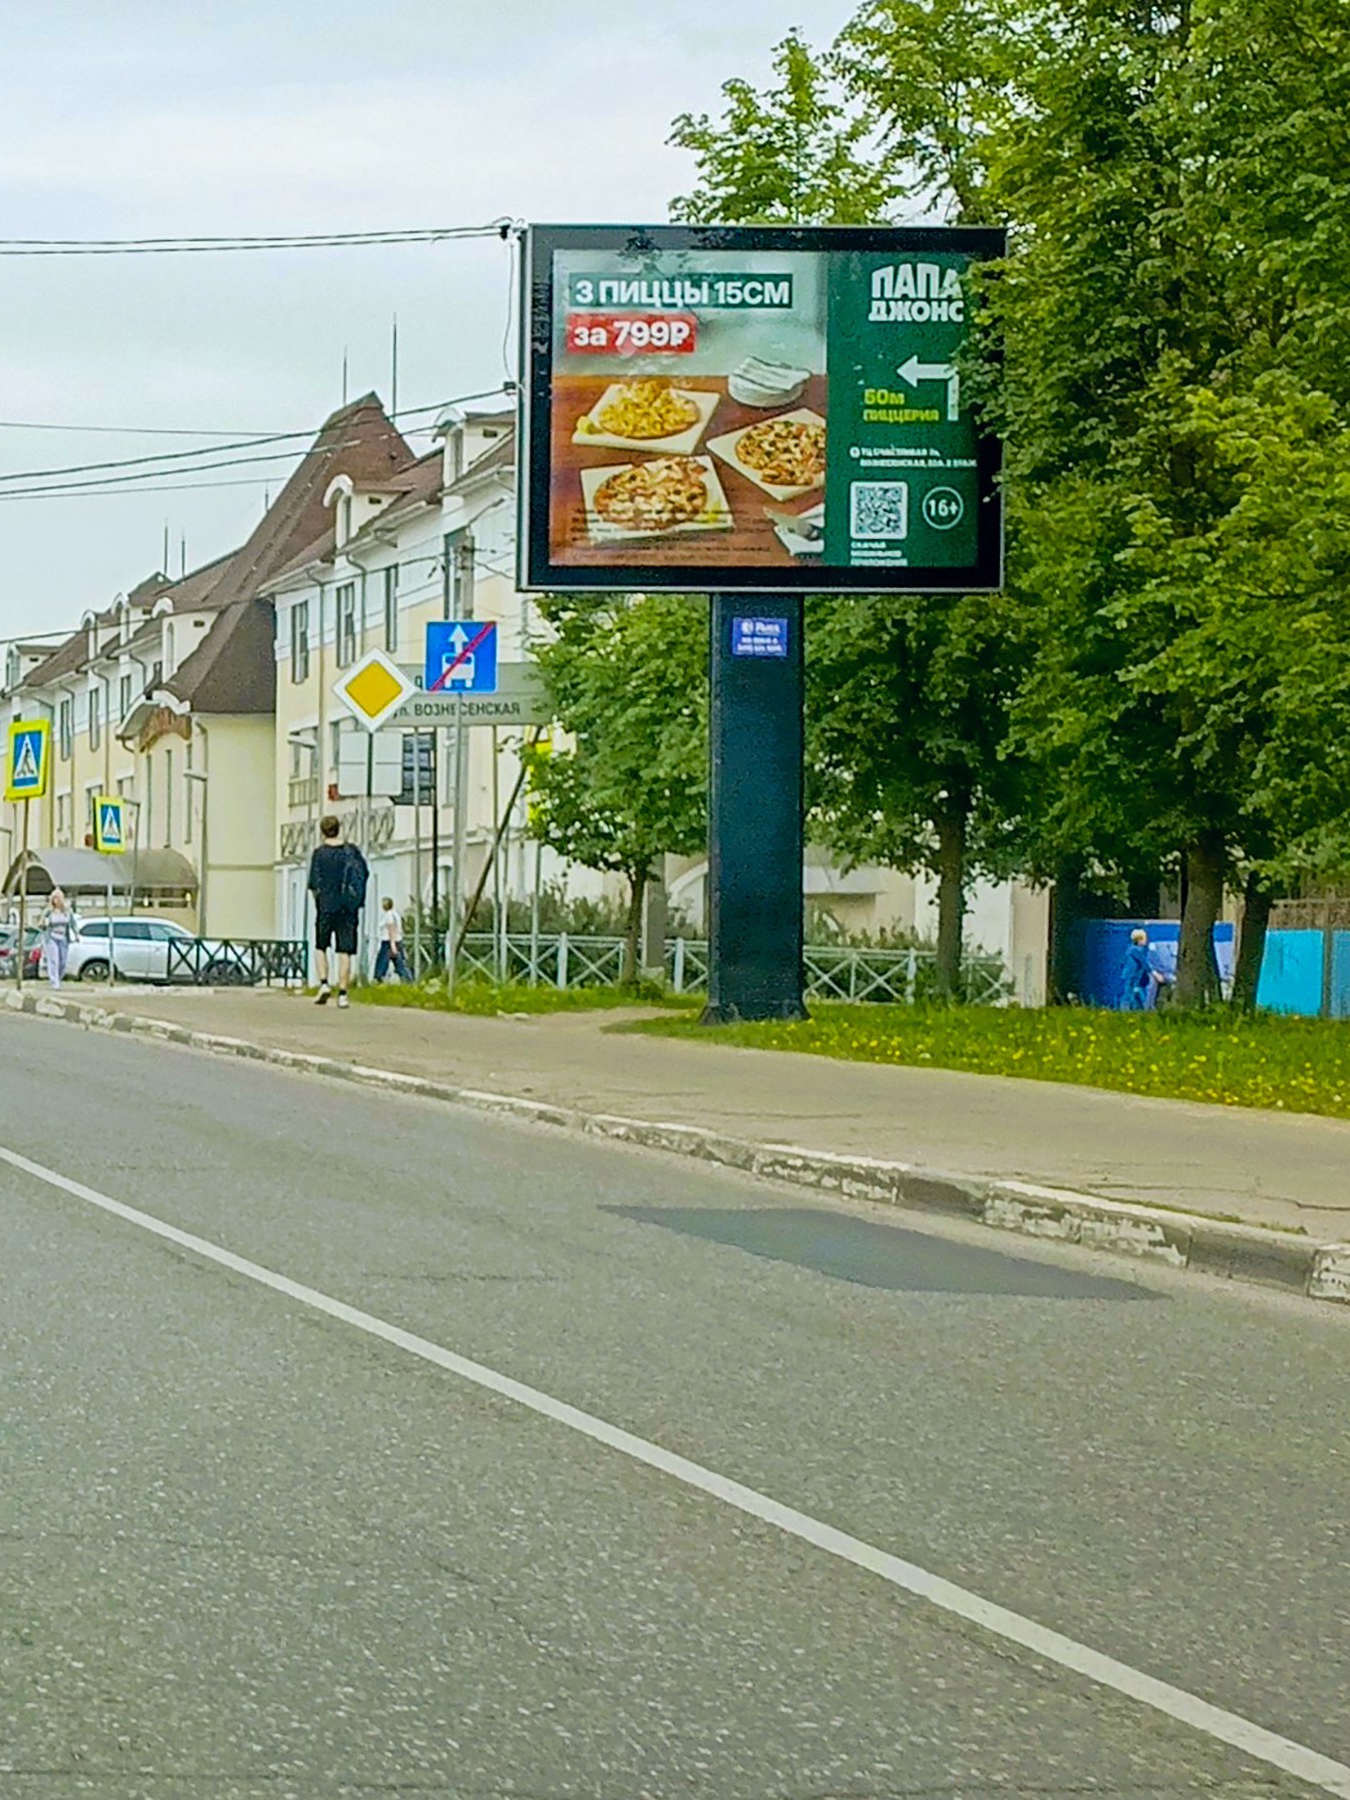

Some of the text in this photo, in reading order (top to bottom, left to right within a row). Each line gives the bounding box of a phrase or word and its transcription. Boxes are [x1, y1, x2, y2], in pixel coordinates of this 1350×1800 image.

[871, 262, 963, 299] ПАПА
[575, 279, 790, 308] 3 ПИЦЦЫ 15СМ
[867, 300, 965, 323] ДЖОНС
[573, 326, 607, 347] за
[928, 498, 959, 518] 16+
[414, 702, 521, 717] ВОЗНЕСЕНСКАЯ
